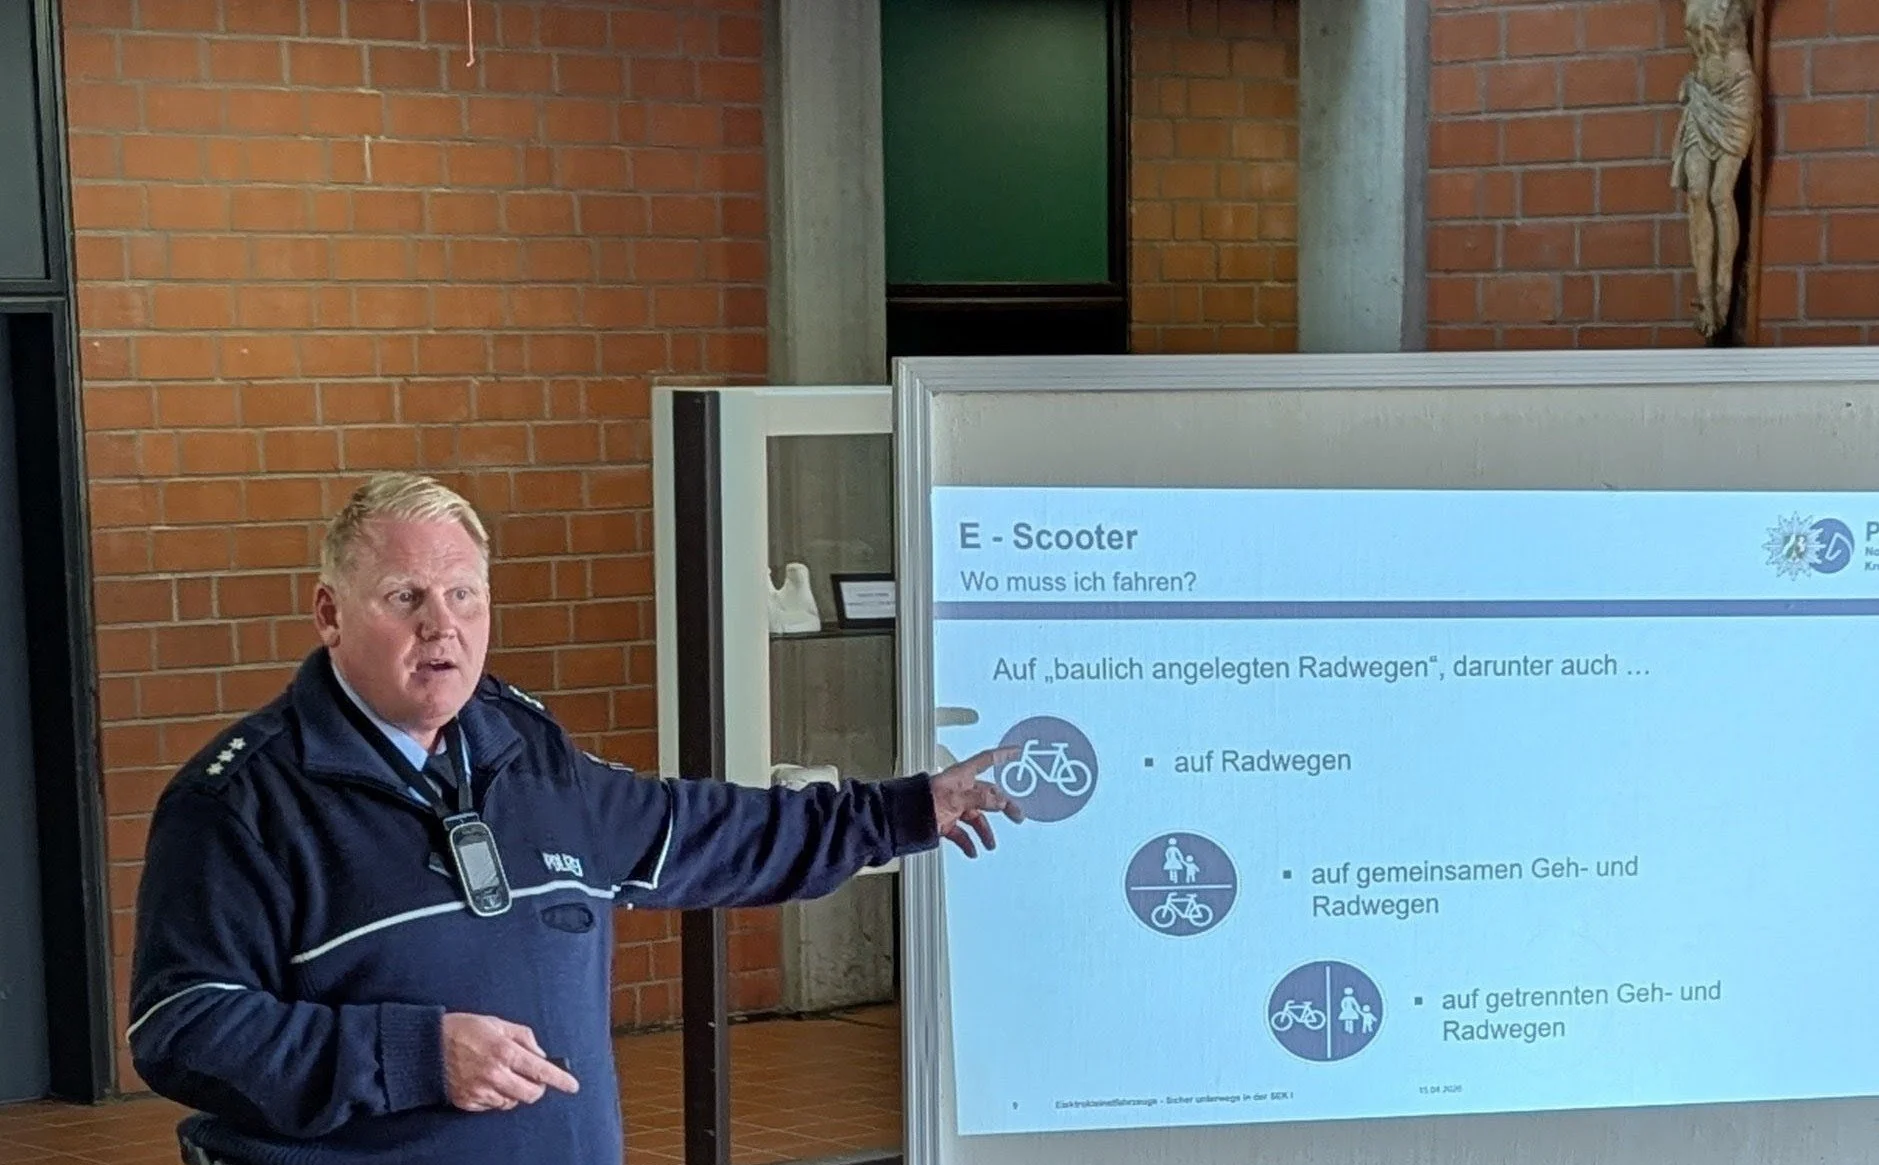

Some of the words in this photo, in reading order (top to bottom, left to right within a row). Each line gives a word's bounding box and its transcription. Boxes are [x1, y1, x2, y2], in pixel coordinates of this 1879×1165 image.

[959, 521, 982, 549] E
[1012, 522, 1139, 551] Scooter
[960, 571, 999, 592] Wo
[1006, 576, 1067, 592] muss
[1074, 571, 1106, 592] ich
[1112, 570, 1197, 592] fahren?
[992, 656, 1038, 681] Auf
[1152, 656, 1290, 686] angelegten
[1453, 654, 1554, 677] darunter
[1560, 653, 1618, 676] auch
[1174, 749, 1215, 774] auf
[1221, 749, 1352, 777] Radwegen
[542, 852, 583, 877] POLIZEI
[1311, 861, 1351, 884] auf
[1356, 859, 1523, 888] gemeinsamen
[1531, 856, 1589, 879] Geh-
[1597, 855, 1639, 877] und
[1312, 893, 1440, 921] Radwegen
[1442, 987, 1481, 1010] auf
[1486, 984, 1609, 1014] getrennten
[1616, 981, 1673, 1004] Geh-
[1680, 979, 1721, 1001] und
[1443, 1016, 1566, 1044] Radwegen
